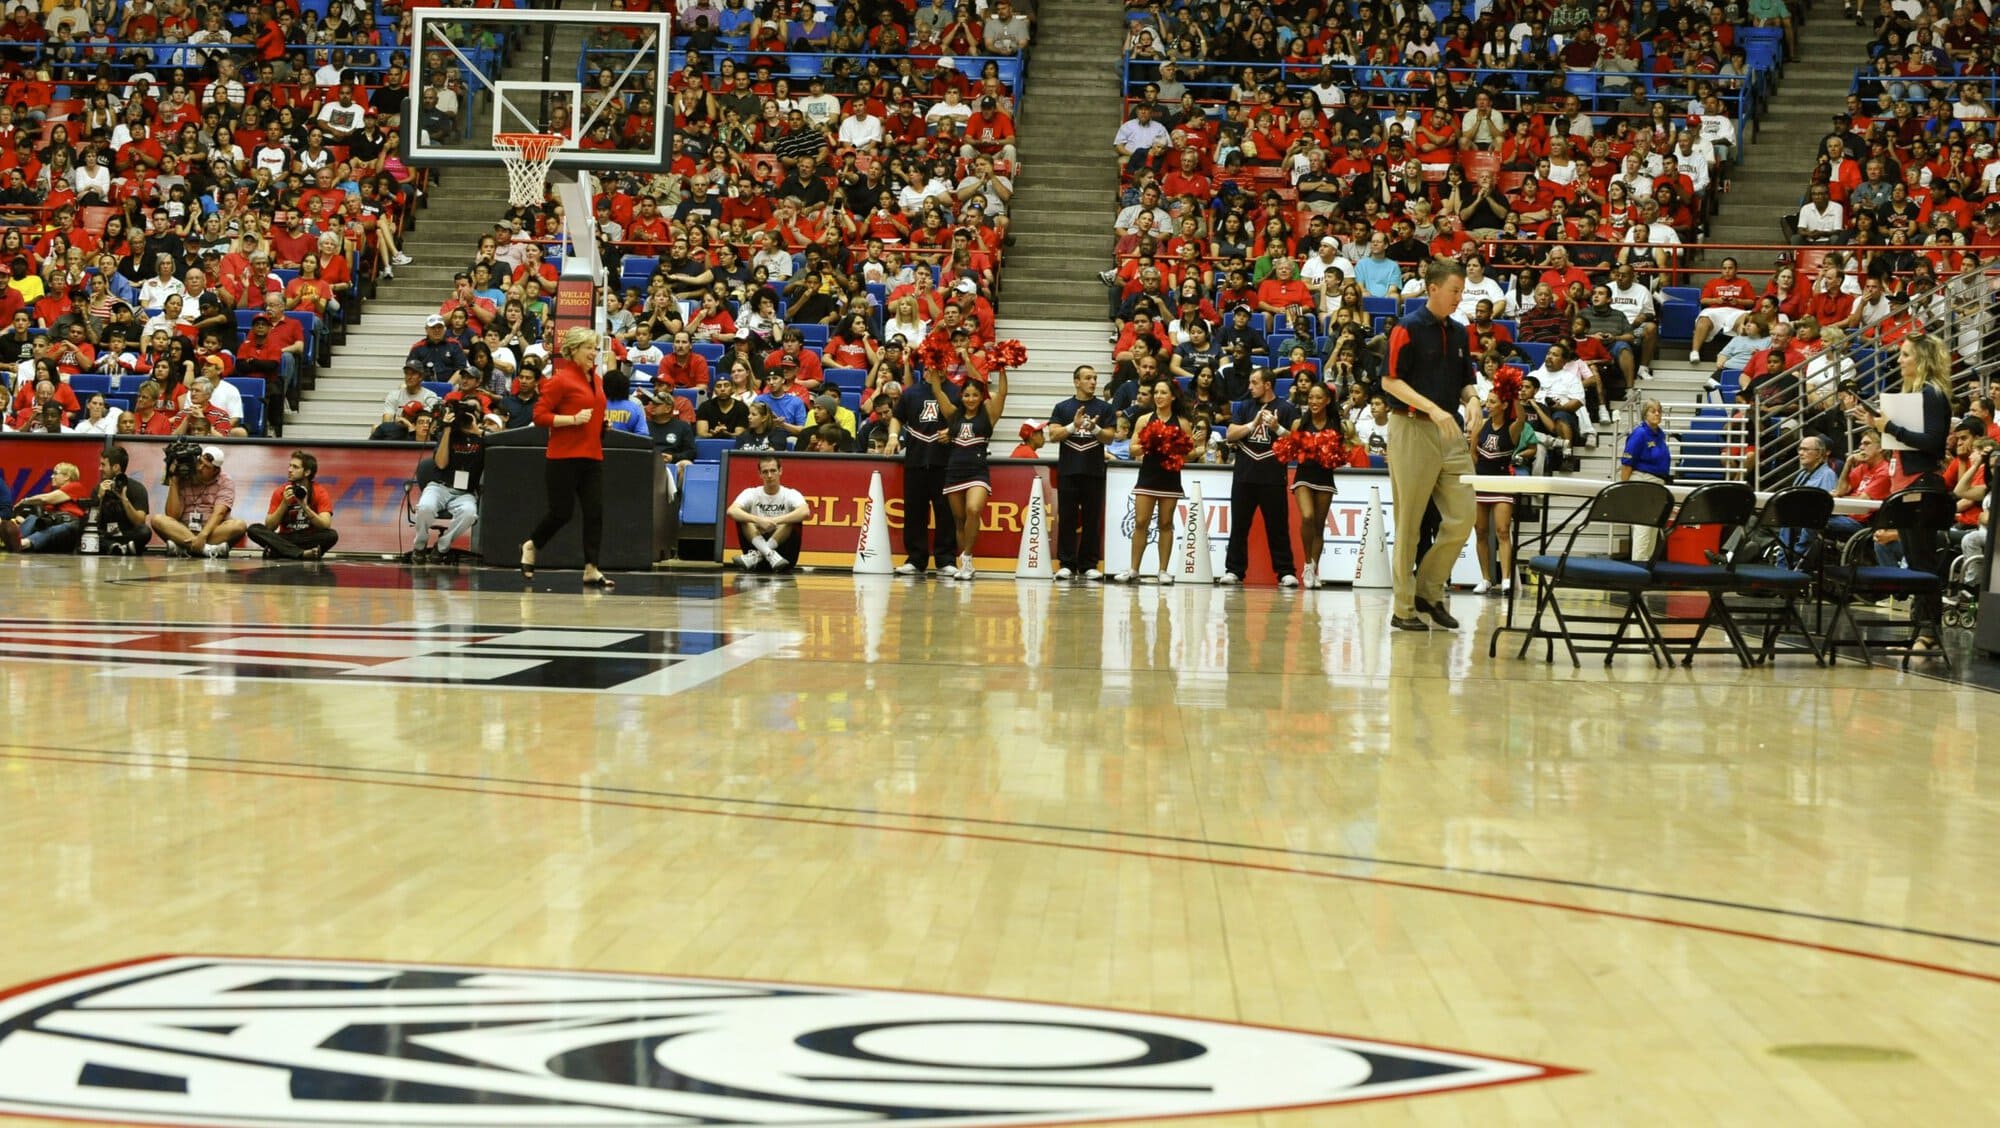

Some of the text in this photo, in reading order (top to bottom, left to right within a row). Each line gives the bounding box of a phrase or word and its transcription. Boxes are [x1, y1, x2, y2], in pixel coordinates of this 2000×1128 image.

[919, 400, 939, 422] A
[960, 423, 975, 438] A
[1484, 434, 1499, 450] A
[801, 496, 905, 529] ELLS
[859, 497, 873, 552] ARIZONA
[1028, 496, 1041, 568] BEARDOWN
[1185, 502, 1199, 574] BEARDOWN
